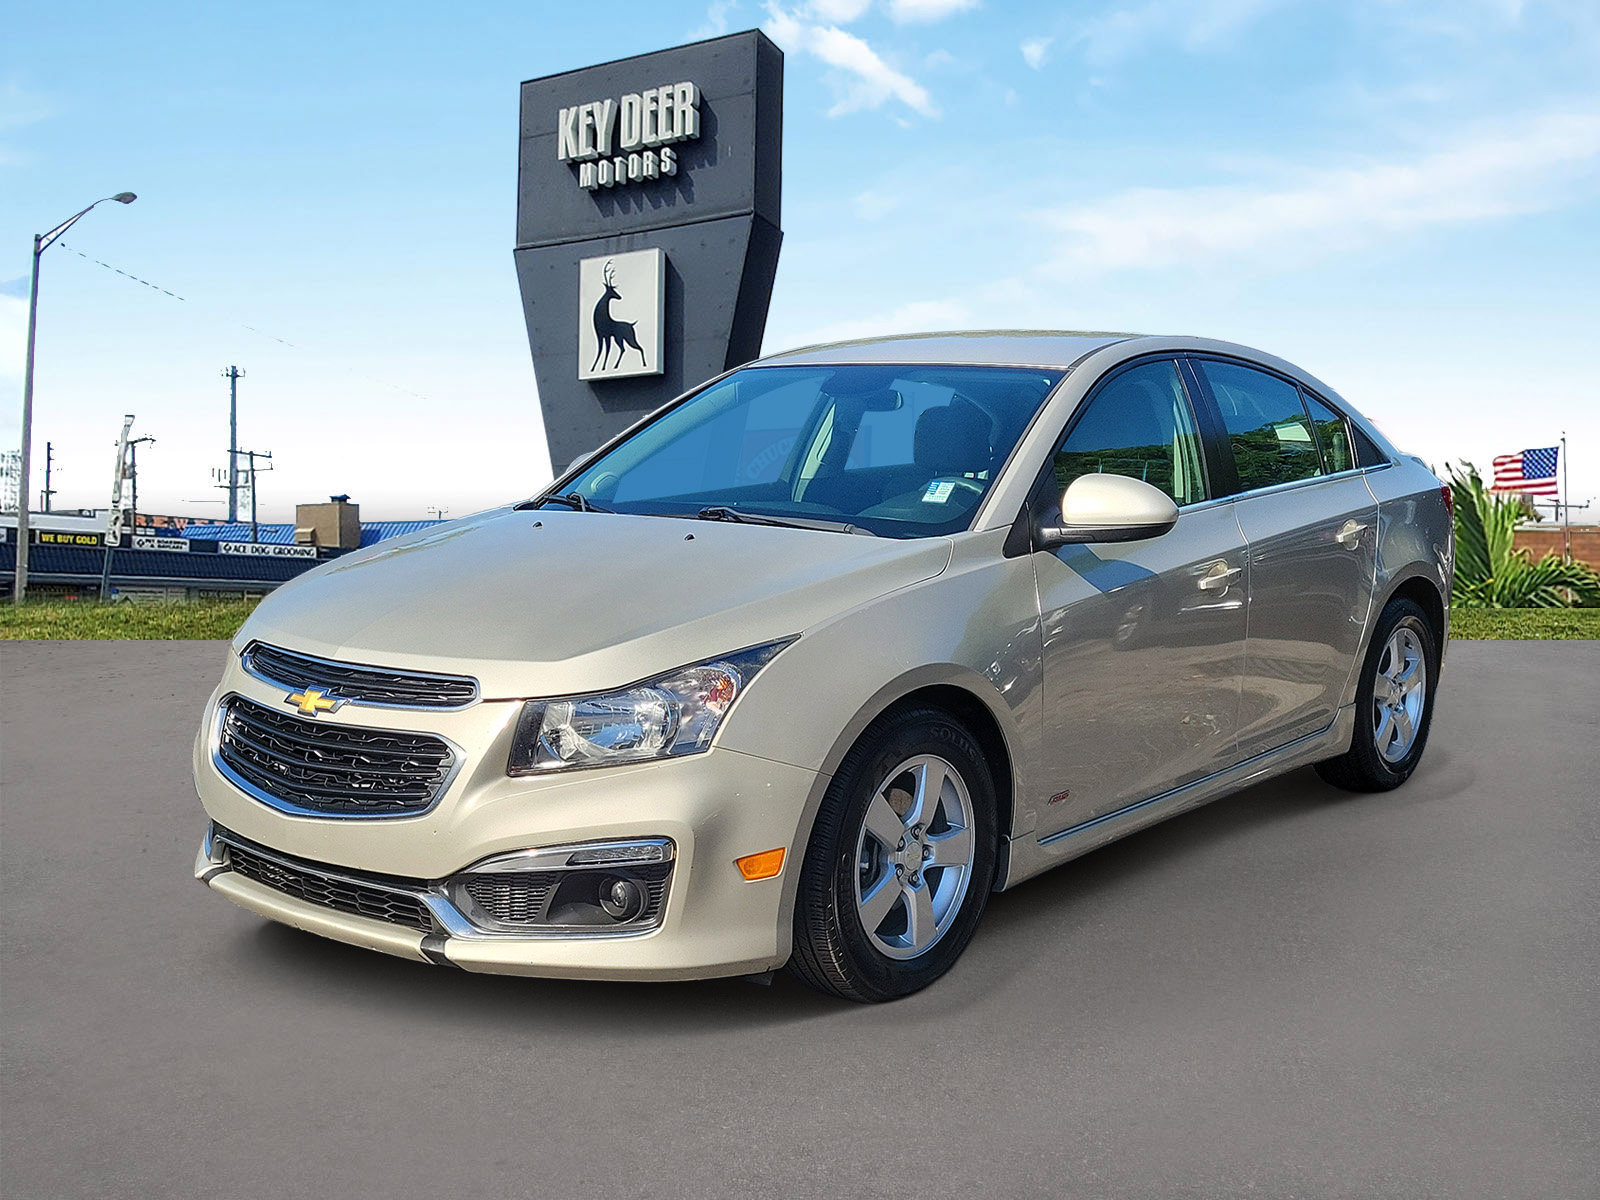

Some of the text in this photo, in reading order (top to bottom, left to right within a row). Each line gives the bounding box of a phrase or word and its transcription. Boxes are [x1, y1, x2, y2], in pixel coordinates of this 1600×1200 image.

[558, 81, 700, 163] KEY DEER
[579, 147, 677, 190] MOTORS
[746, 436, 799, 479] CHUC
[41, 533, 97, 545] WE BUY GOLD
[232, 545, 315, 557] ACE DOG GROOMING
